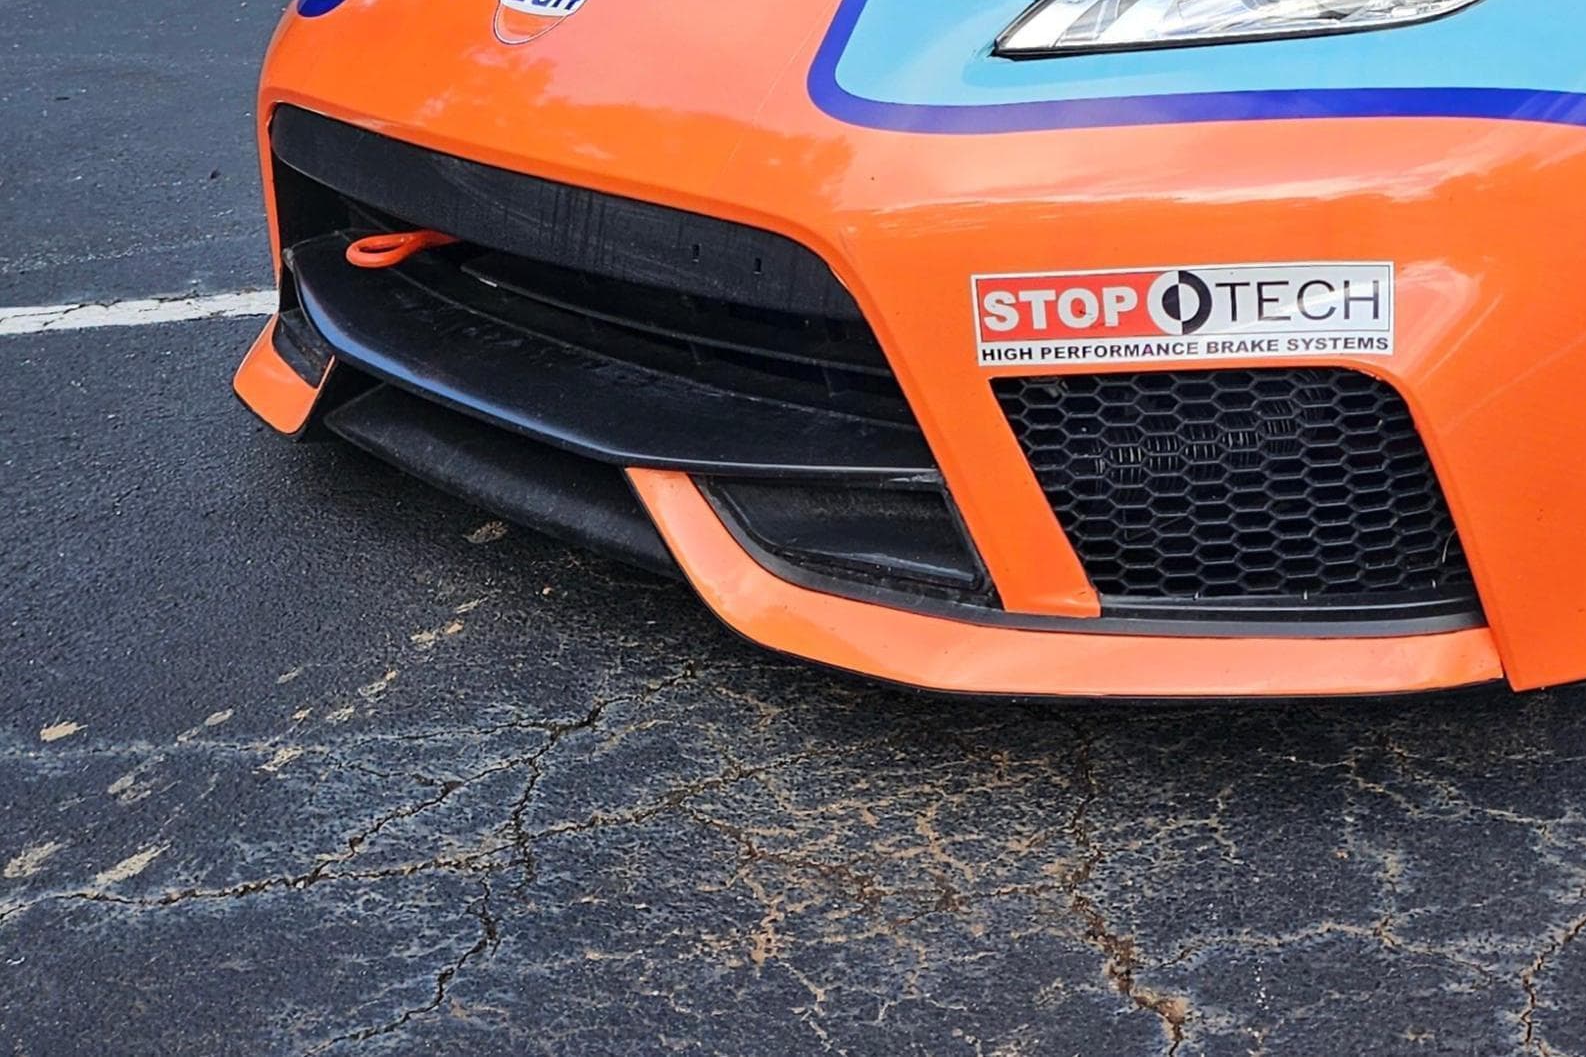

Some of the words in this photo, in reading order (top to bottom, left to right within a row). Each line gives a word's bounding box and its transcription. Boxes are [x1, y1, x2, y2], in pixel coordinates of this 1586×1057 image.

[982, 284, 1138, 331] STOP
[1214, 279, 1381, 323] TECH
[981, 346, 1034, 362] HIGH
[1040, 340, 1200, 360] PERFORMANCE
[1206, 338, 1281, 355] BRAKE
[1286, 335, 1390, 352] SYSTEMS
